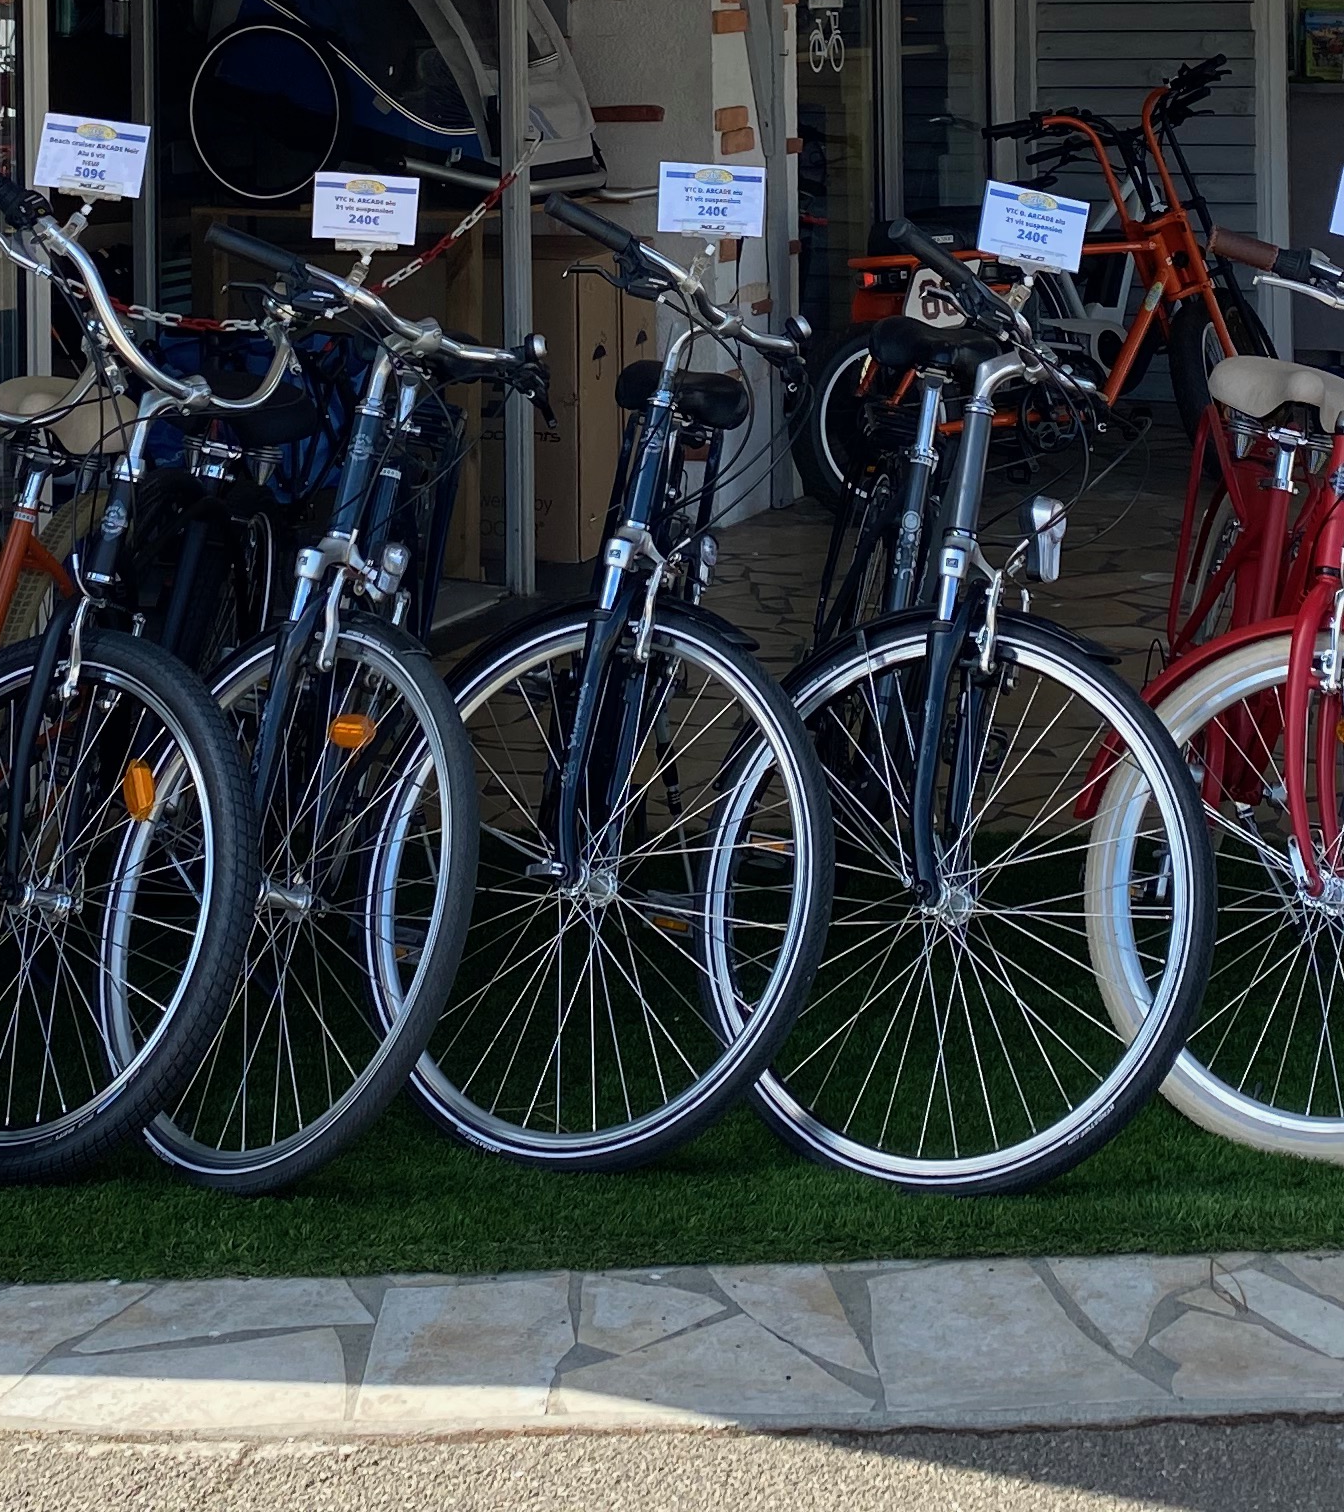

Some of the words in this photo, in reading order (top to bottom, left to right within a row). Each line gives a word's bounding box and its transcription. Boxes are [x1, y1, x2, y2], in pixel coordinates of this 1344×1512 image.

[96, 143, 123, 152] ARCADE
[74, 167, 107, 181] 509€
[357, 197, 384, 206] ARCADE
[697, 206, 728, 217] 240€
[348, 214, 380, 226] 240€
[1027, 212, 1054, 223] ARCADE
[1016, 229, 1048, 244] 240€
